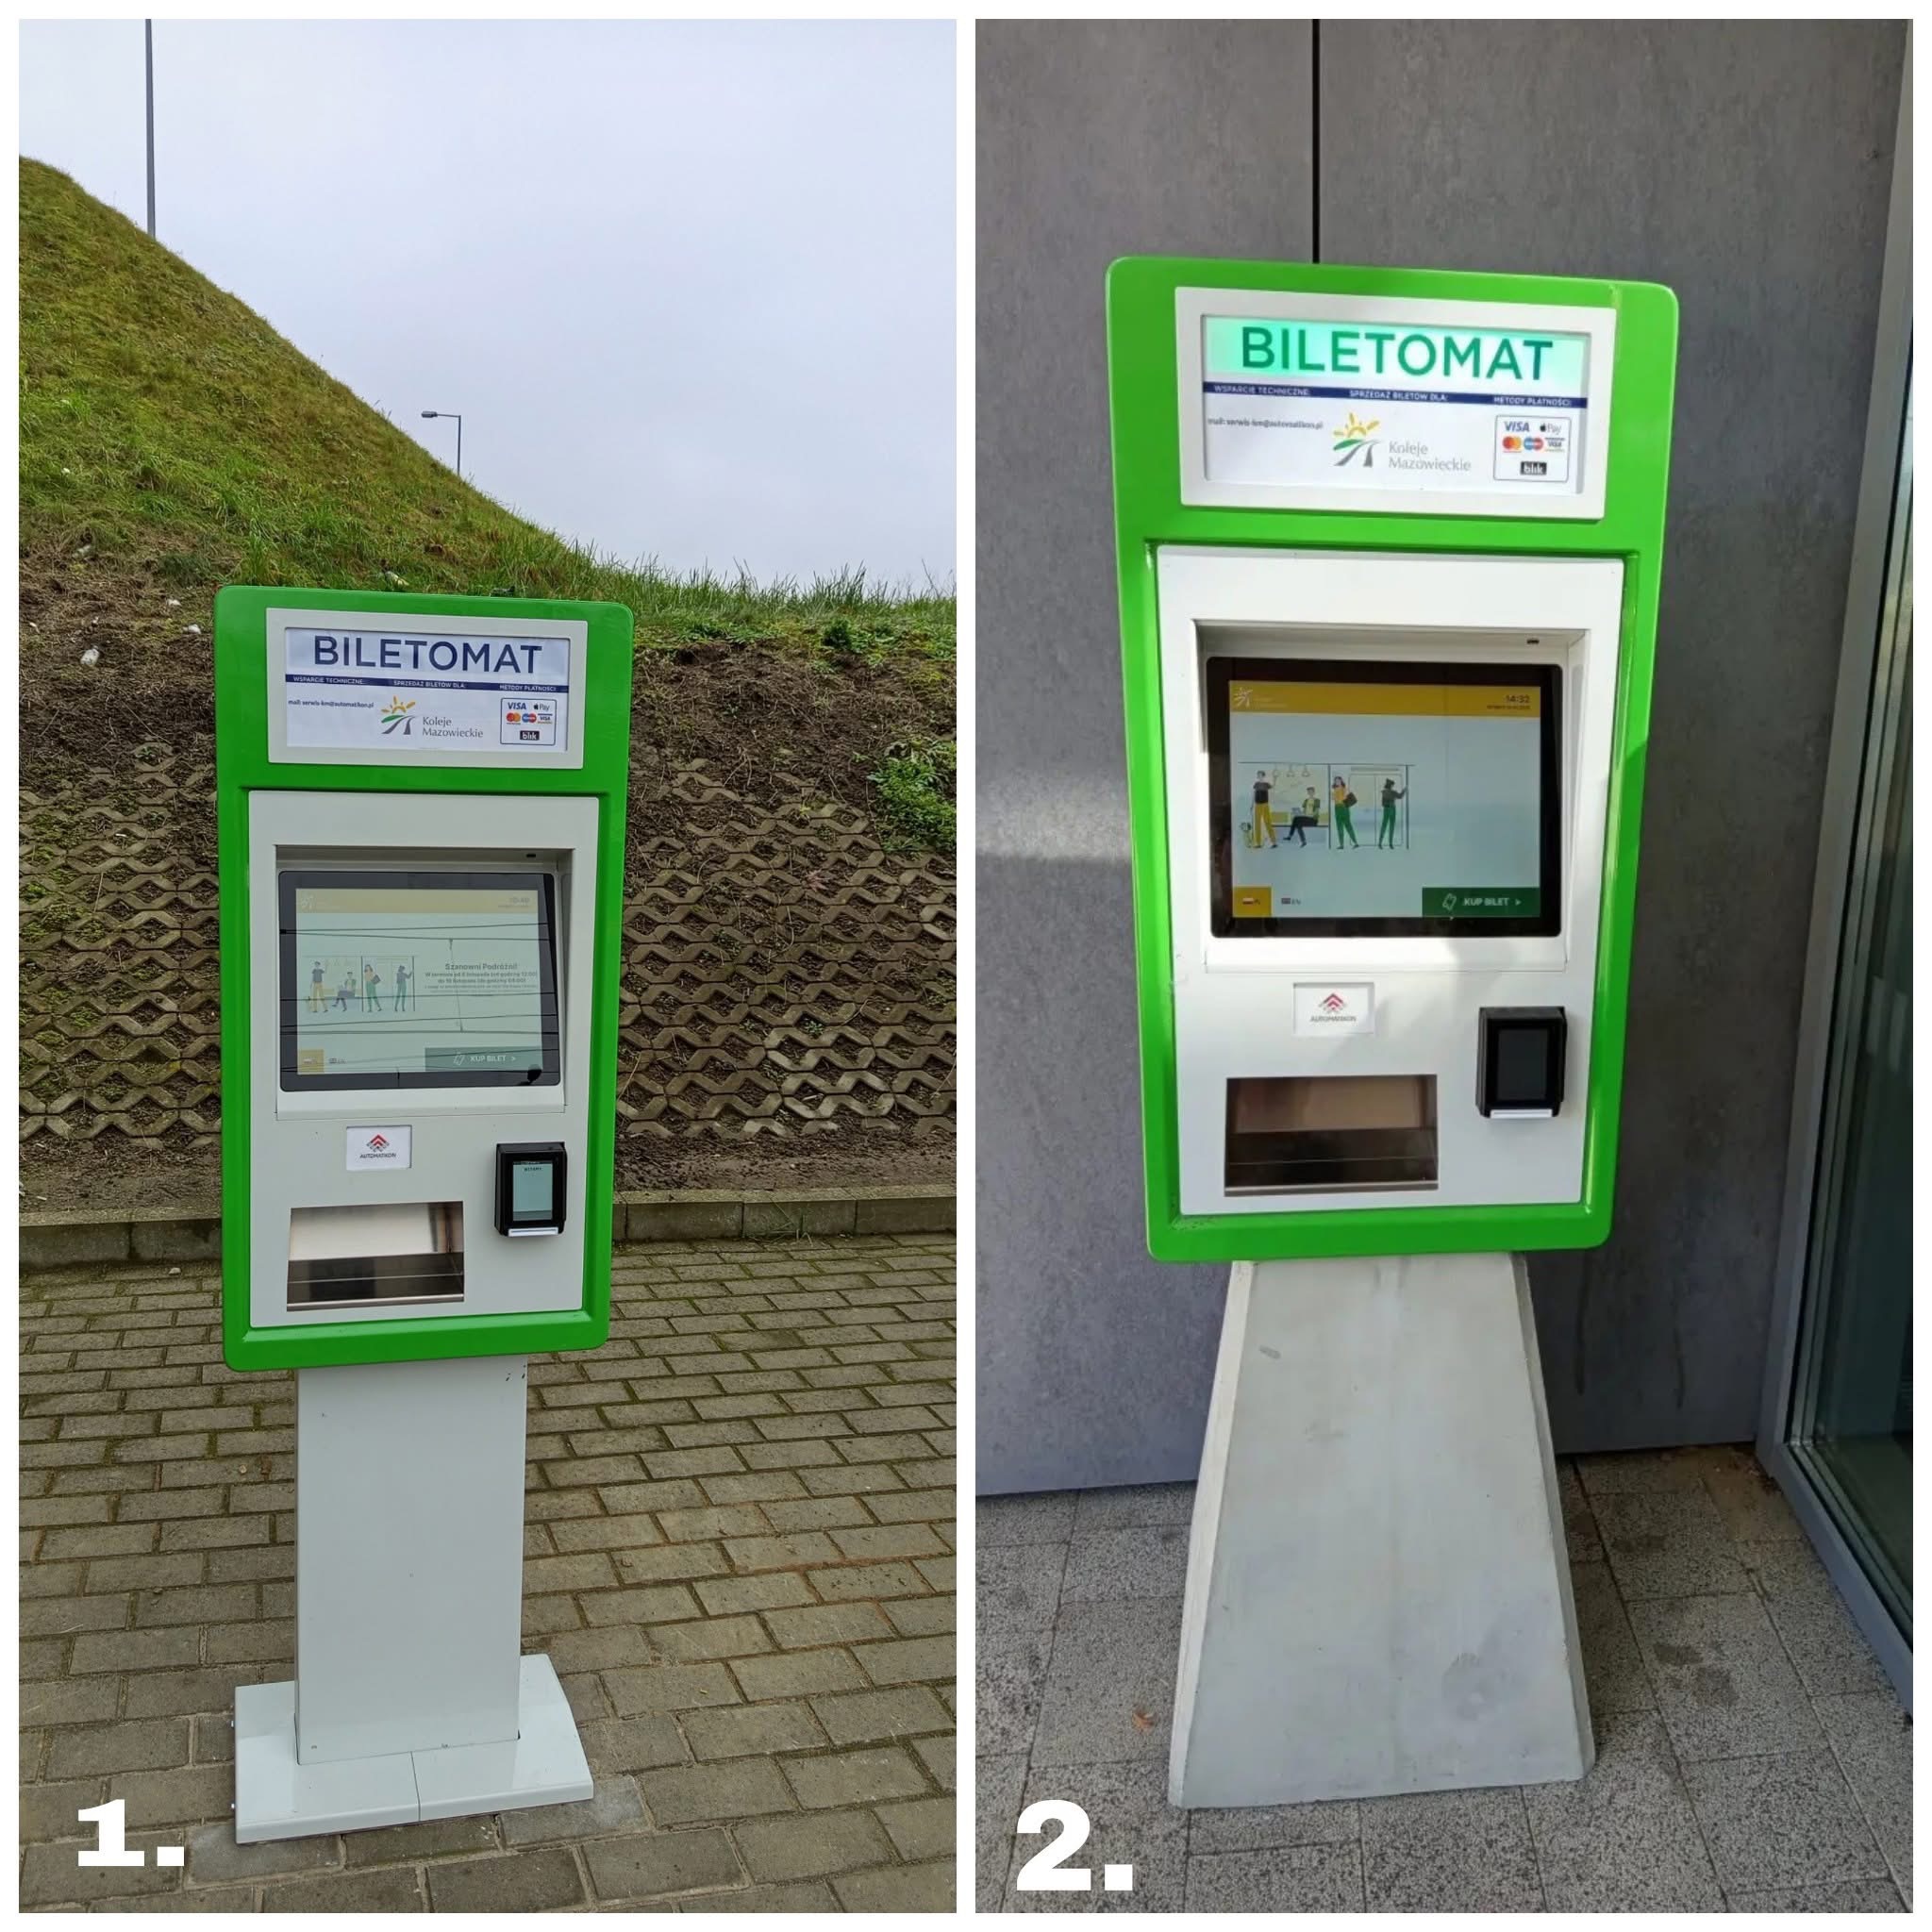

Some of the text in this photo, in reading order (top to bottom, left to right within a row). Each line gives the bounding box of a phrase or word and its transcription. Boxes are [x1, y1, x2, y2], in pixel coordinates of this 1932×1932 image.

[1241, 325, 1553, 381] BILETOMAT
[1214, 385, 1256, 393] WSPARCIE
[1350, 389, 1391, 398] SPRZEDAŻ
[1392, 391, 1427, 400] BILETÓW
[1504, 421, 1530, 432] VISA
[1547, 423, 1561, 435] Pay
[1389, 441, 1428, 456] Koleje
[1389, 457, 1472, 472] Mazowieckie
[314, 635, 542, 674] BILETOMAT
[539, 703, 550, 711] Pay
[422, 716, 452, 727] Koleje
[422, 727, 484, 738] Mazowieckie
[522, 731, 537, 740] blik
[1464, 897, 1509, 906] KUP BILET
